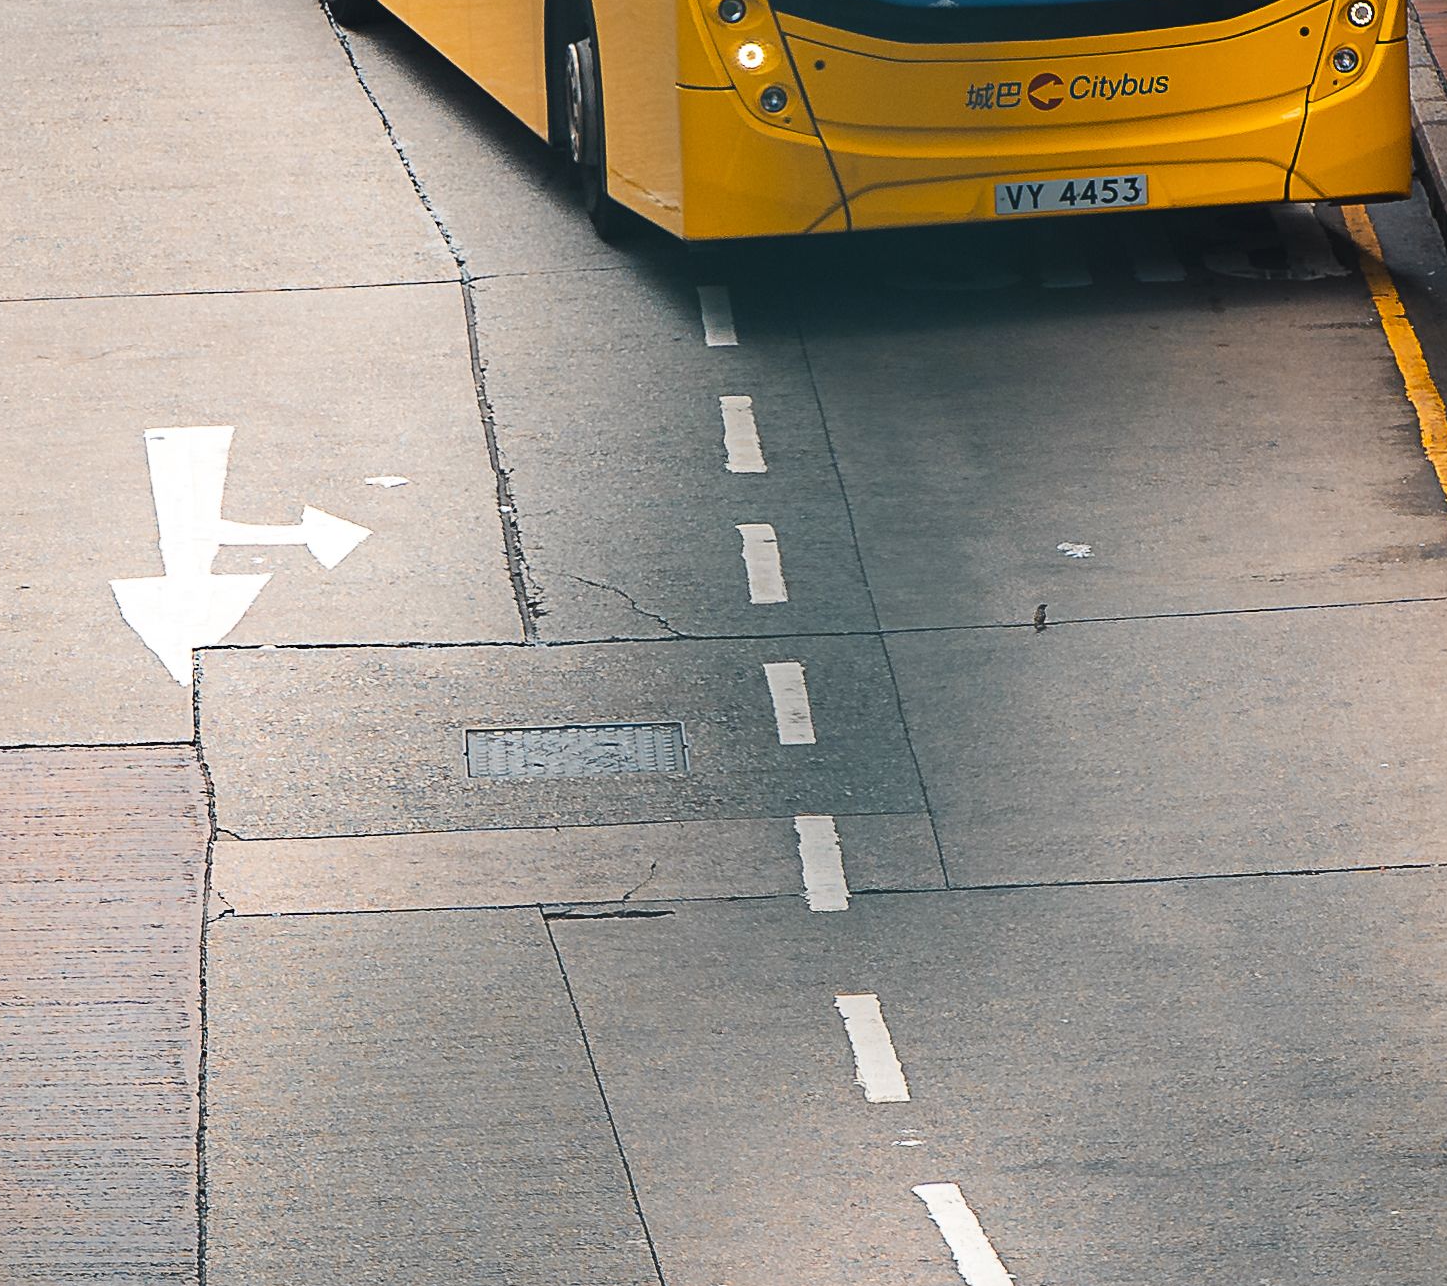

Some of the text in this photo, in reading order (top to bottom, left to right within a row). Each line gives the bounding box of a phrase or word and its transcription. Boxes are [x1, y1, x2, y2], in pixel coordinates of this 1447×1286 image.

[965, 72, 1169, 110] 城巴 Citybus
[1006, 177, 1140, 210] VY 4453
